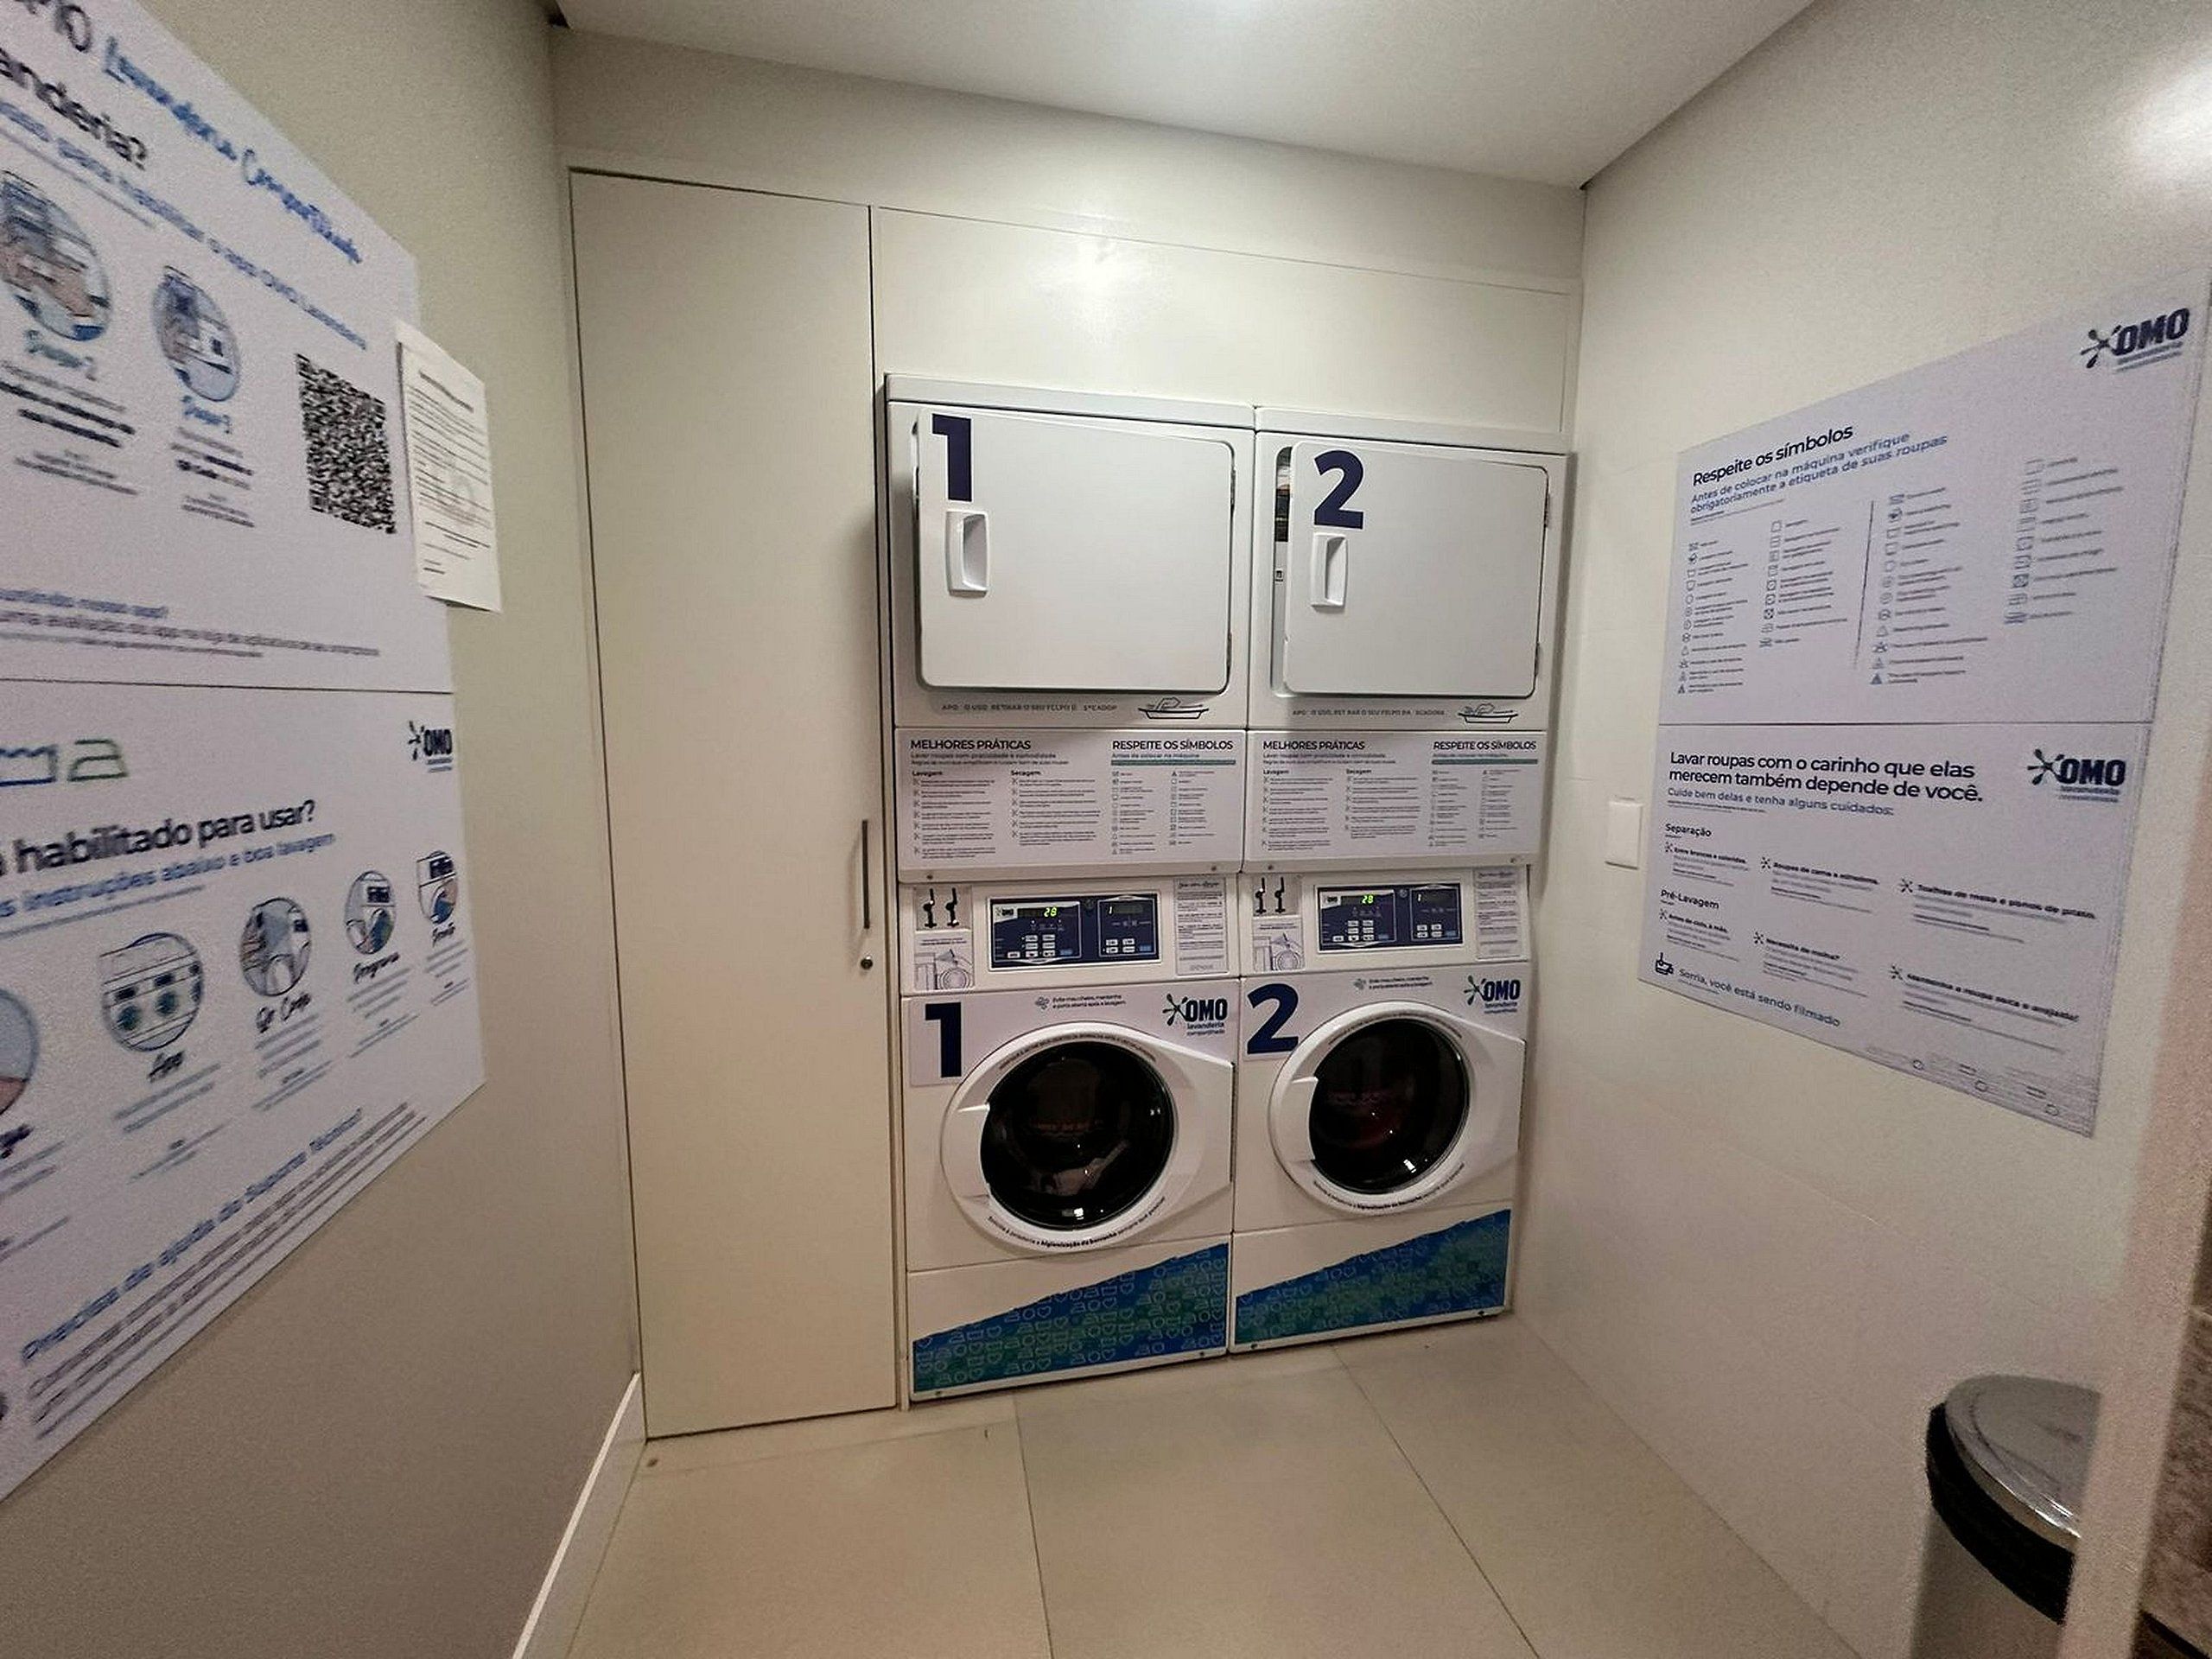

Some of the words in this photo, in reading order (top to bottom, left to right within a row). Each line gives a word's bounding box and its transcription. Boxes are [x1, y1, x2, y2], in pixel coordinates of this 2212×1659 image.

[2111, 308, 2190, 356] OMO
[932, 414, 972, 502] 1
[1691, 489, 1718, 503] Antes
[1719, 483, 1732, 496] de
[1734, 473, 1772, 491] colocar
[1775, 468, 1789, 479] na
[1792, 450, 1845, 474] máquina
[1847, 433, 1910, 458] verifique
[1693, 457, 1752, 486] Respeite
[1755, 452, 1773, 466] os
[1776, 426, 1853, 461] símbolos
[1690, 484, 1777, 513] obrigatoriamente
[1778, 481, 1787, 490] a
[1789, 467, 1839, 488] etiqueta
[1841, 457, 1858, 472] de
[1861, 450, 1891, 467] suas
[1896, 435, 1948, 458] roupas
[1313, 449, 1364, 530] 2
[423, 728, 453, 757] OMO
[910, 740, 975, 749] MELHORES
[976, 738, 1031, 749] PRÁTICAS
[1112, 741, 1162, 750] RESPEITE
[1163, 741, 1179, 750] OS
[1180, 739, 1234, 750] SÍMBOLOS
[1262, 741, 1318, 750] MELHORES
[1319, 740, 1365, 750] PRÁTICAS
[1433, 741, 1476, 750] RESPEITE
[1476, 741, 1490, 750] OS
[1491, 739, 1536, 750] SÍMBOLOS
[1670, 752, 1705, 766] Lavar
[1707, 754, 1755, 770] roupas
[1758, 757, 1792, 770] com
[1796, 759, 1807, 770] o
[1810, 756, 1880, 774] carinho
[1884, 761, 1925, 779] que
[1930, 760, 1975, 779] elas
[2057, 758, 2126, 786] OMO
[1668, 787, 1693, 798] Cuide
[1694, 790, 1716, 800] bem
[1718, 791, 1744, 803] delas
[1745, 795, 1752, 804] e
[1754, 794, 1786, 806] tenha
[1788, 797, 1828, 810] alguns
[1669, 769, 1732, 785] merecem
[1735, 772, 1802, 789] também
[1805, 775, 1889, 796] depende
[1893, 781, 1920, 798] de
[1925, 784, 1983, 803] você.
[199, 813, 256, 849] para
[259, 799, 316, 831] usar?
[1665, 823, 1712, 837] Separação
[1660, 888, 1719, 909] Pré-Lavagem
[1483, 979, 1521, 1002] OMO
[1679, 968, 1707, 985] Sorria,
[1709, 977, 1732, 993] você
[1734, 986, 1756, 1001] está
[1758, 994, 1791, 1012] sendo
[1794, 1003, 1841, 1027] filmado
[1185, 998, 1228, 1022] OMO
[1247, 983, 1299, 1055] 2
[925, 1001, 962, 1078] 1
